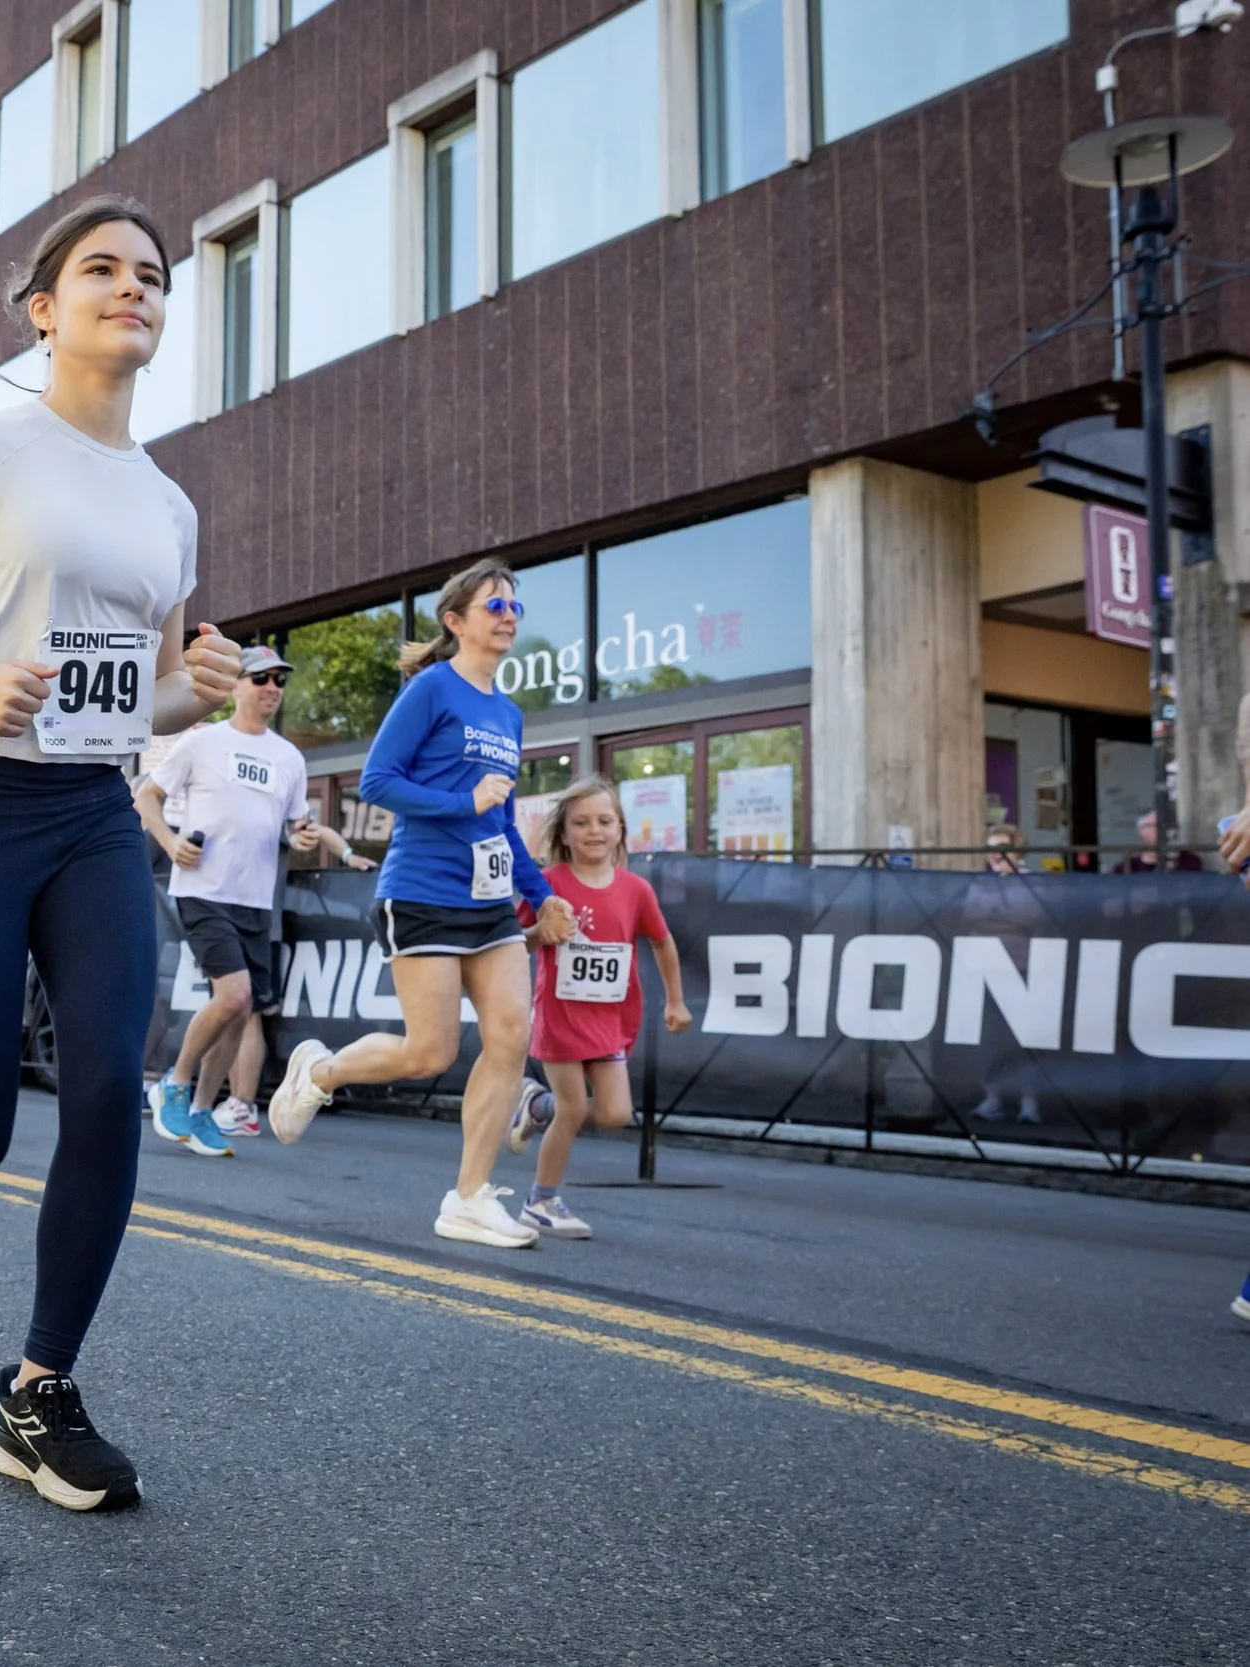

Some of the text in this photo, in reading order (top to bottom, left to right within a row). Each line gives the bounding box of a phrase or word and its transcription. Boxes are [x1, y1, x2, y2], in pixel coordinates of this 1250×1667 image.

[51, 631, 136, 649] BIONIC
[494, 611, 691, 704] ong cha
[58, 659, 139, 714] 949
[45, 737, 146, 746] FOOD DRINK DRINK
[237, 762, 268, 784] 960
[572, 956, 619, 983] 959
[701, 933, 1250, 1060] BIONIC
